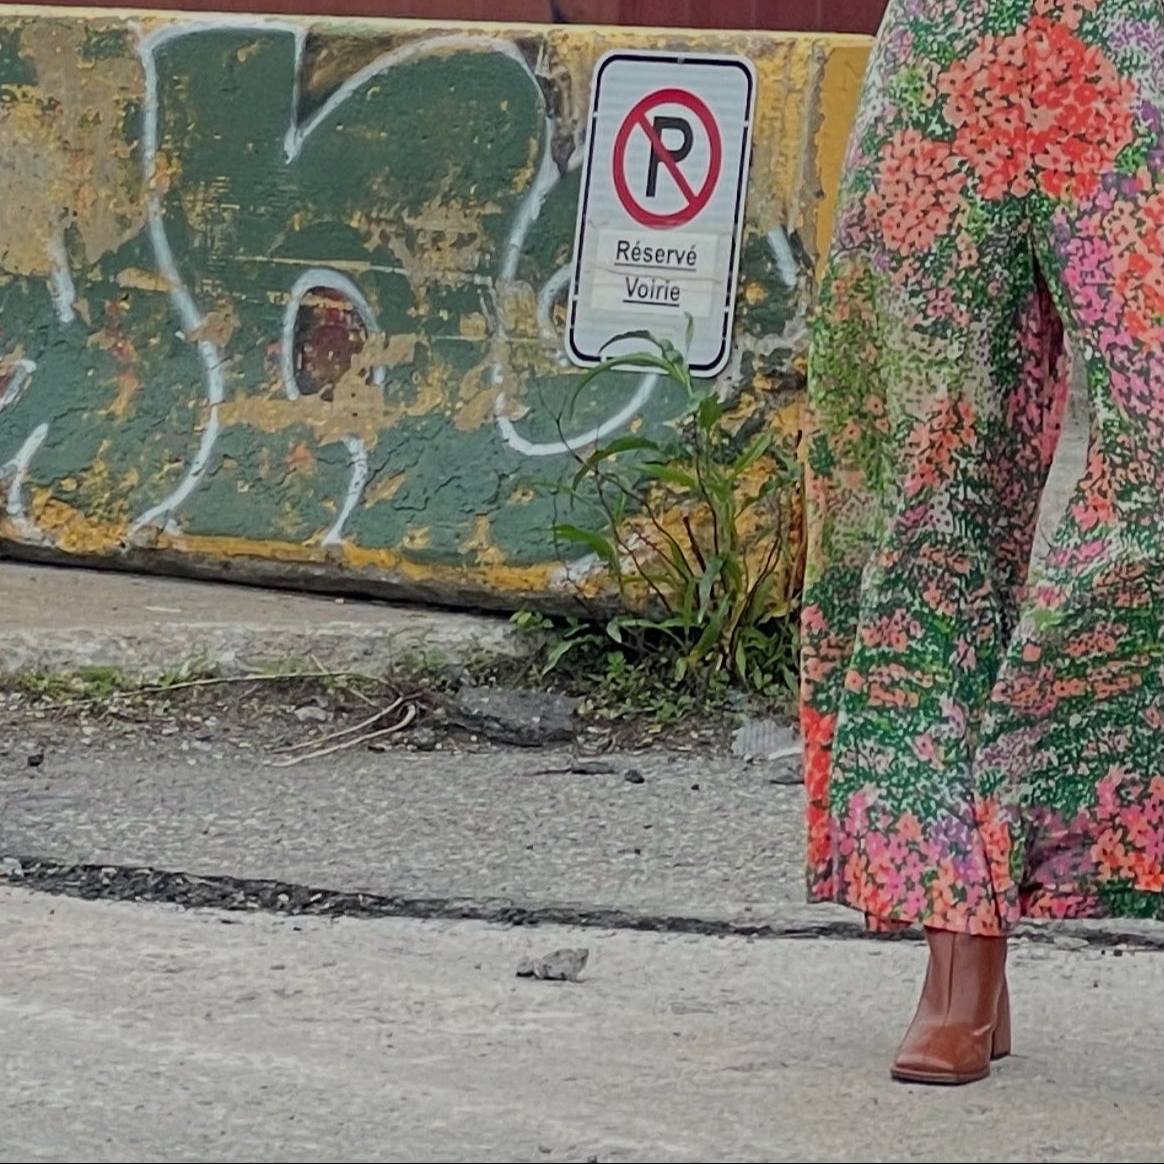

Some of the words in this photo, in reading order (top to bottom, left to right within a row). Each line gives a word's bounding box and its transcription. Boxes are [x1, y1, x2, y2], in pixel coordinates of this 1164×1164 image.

[645, 115, 694, 198] P
[615, 239, 697, 267] Réservé
[625, 276, 680, 301] Voirie
